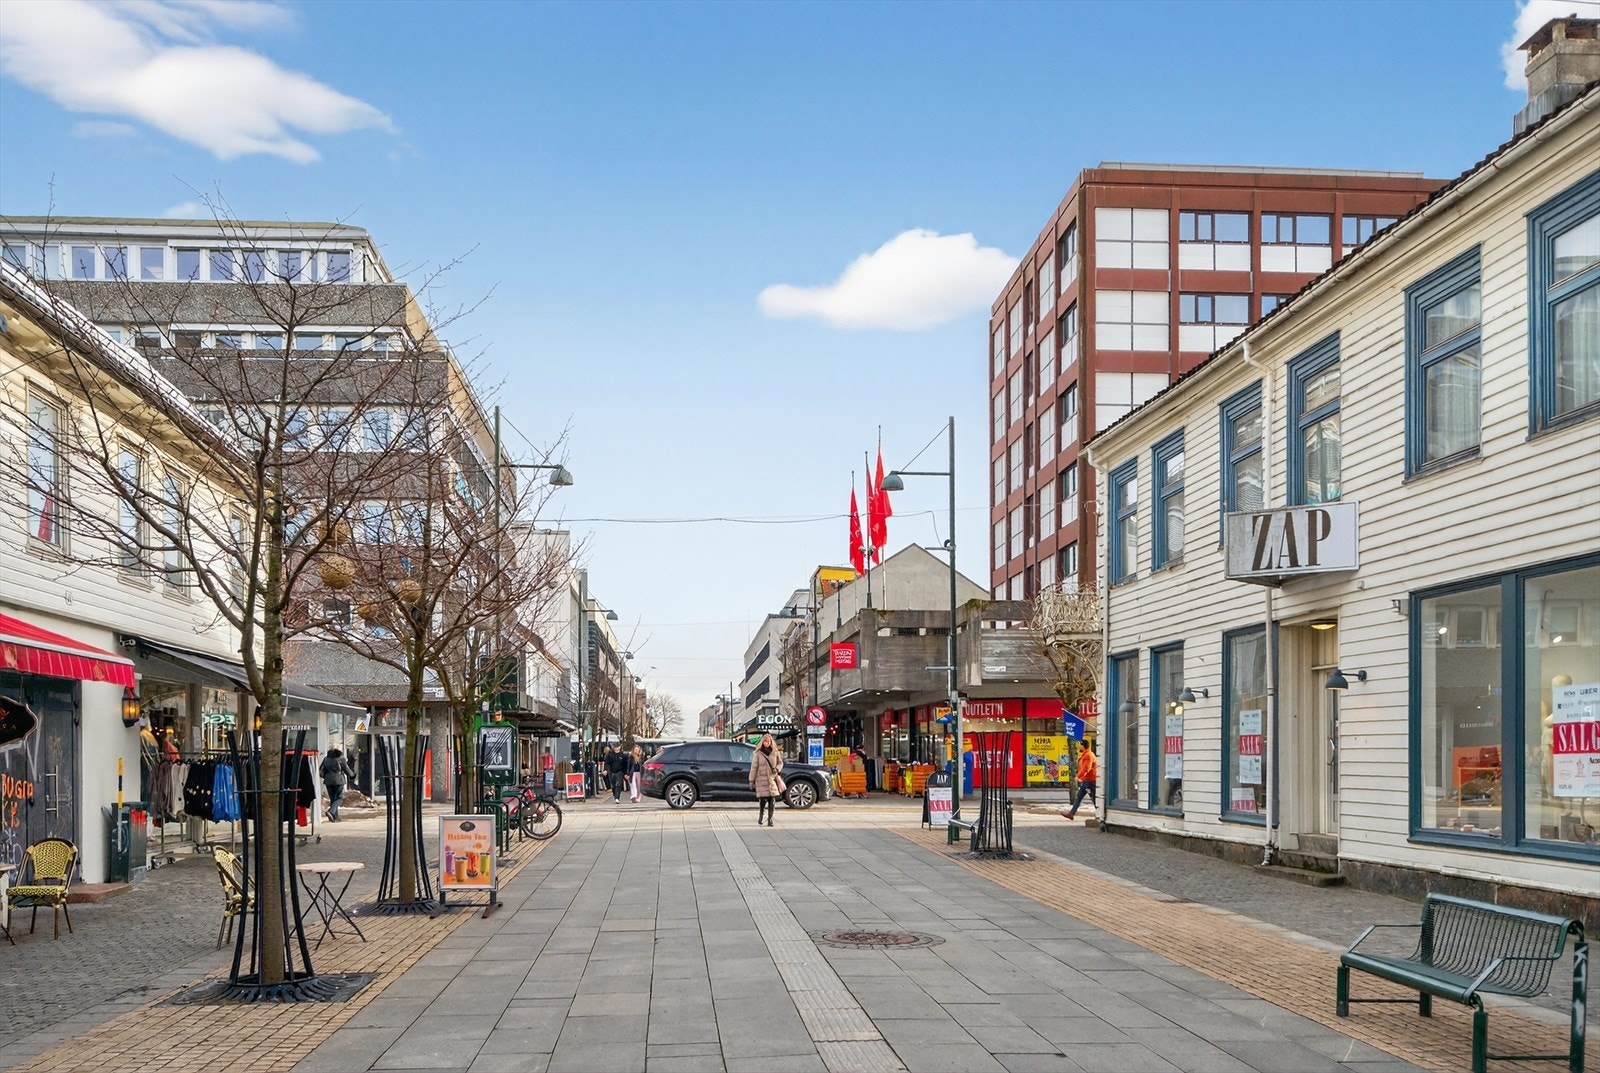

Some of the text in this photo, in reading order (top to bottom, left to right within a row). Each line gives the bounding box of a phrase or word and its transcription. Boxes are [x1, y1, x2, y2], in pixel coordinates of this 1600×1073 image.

[1252, 508, 1331, 571] ZAP
[965, 702, 1004, 716] OUTLET'N
[757, 714, 793, 724] EGON
[1558, 722, 1600, 752] SALG
[936, 774, 949, 784] ZAP
